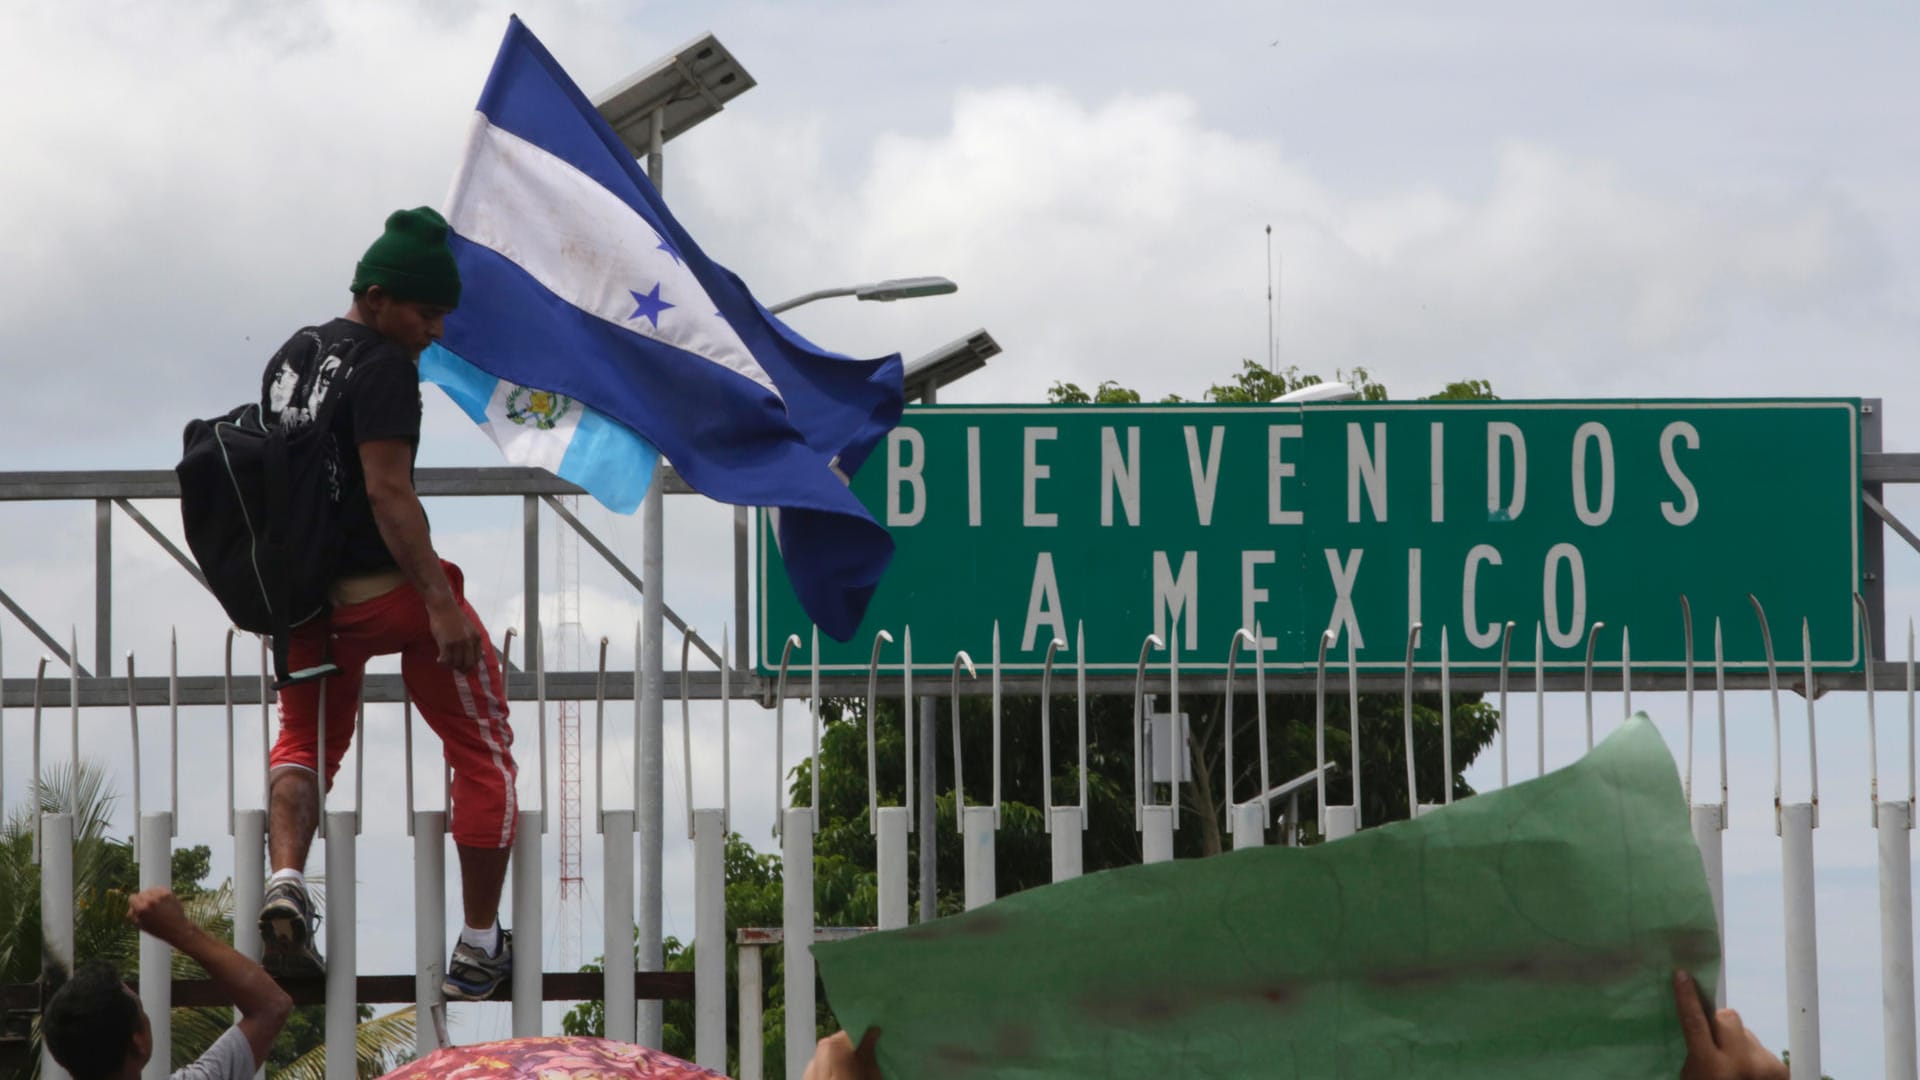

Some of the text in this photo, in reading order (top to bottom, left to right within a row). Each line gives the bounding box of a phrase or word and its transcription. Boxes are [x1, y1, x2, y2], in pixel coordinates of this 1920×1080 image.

[887, 420, 1702, 527] BIENVENIDOS
[1021, 542, 1588, 651] A MEXICO
